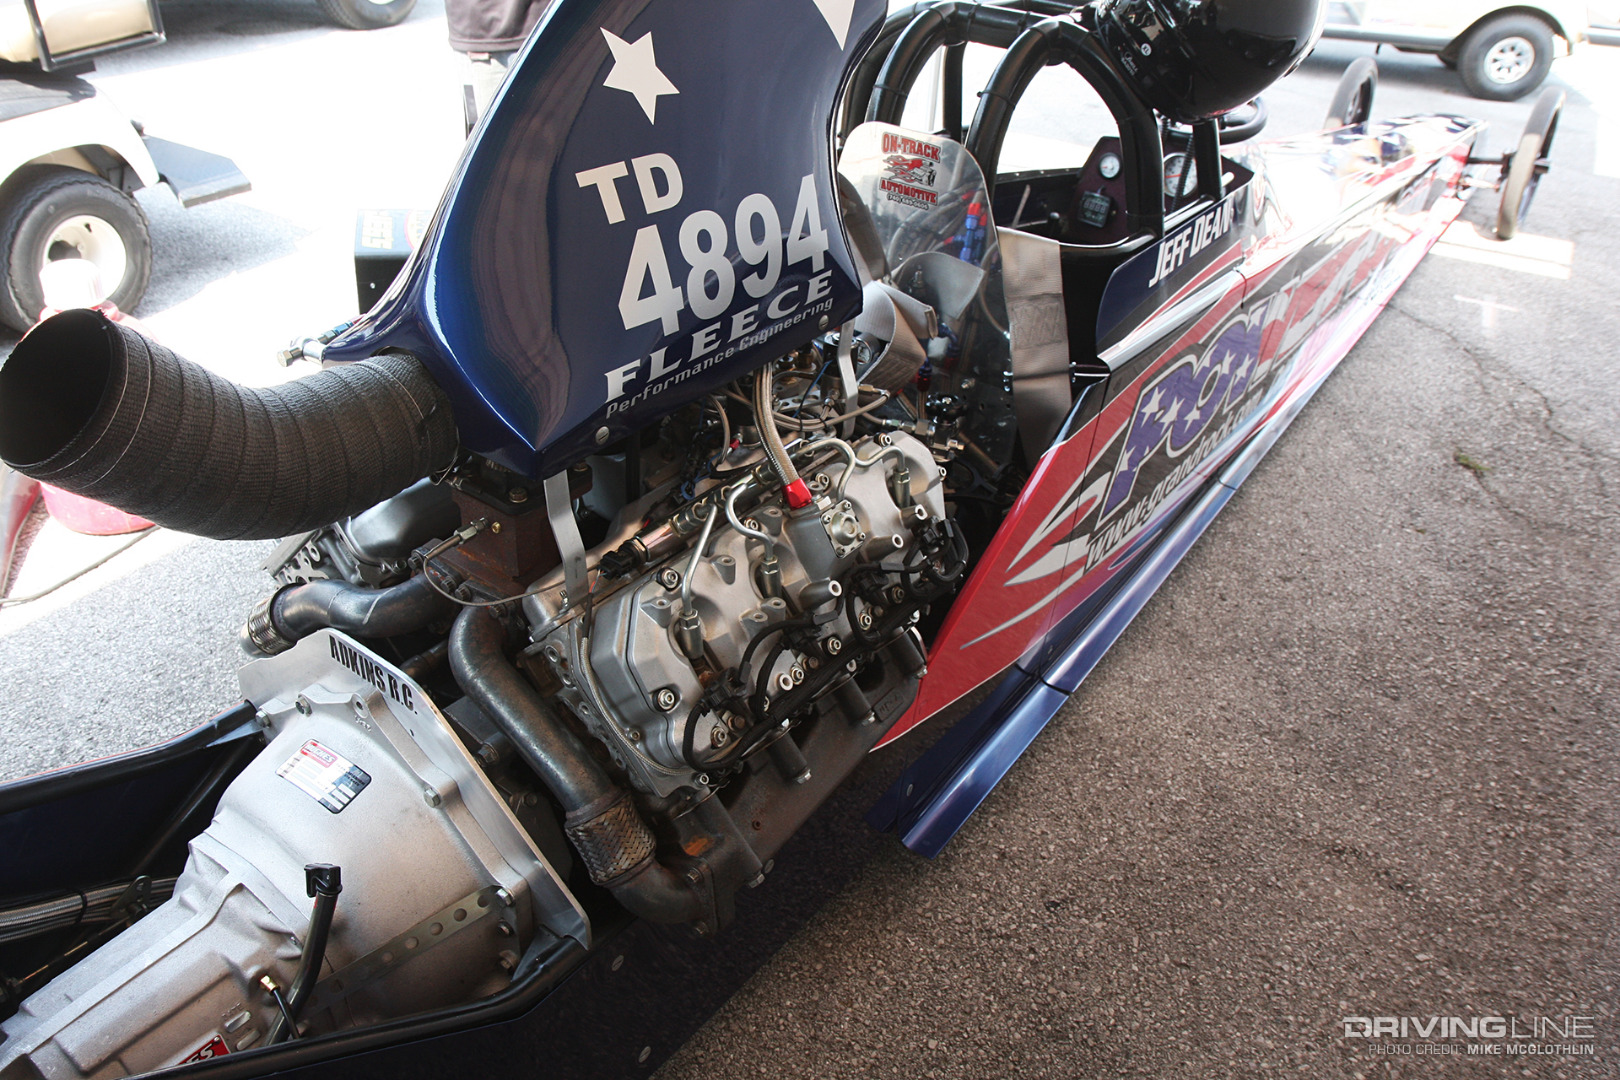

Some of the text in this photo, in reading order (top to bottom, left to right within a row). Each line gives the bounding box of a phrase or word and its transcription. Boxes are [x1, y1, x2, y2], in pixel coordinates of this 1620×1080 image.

[575, 153, 683, 225] TD
[881, 132, 941, 163] ON-TRACK
[880, 178, 937, 204] AUTOMOTIVE
[618, 173, 829, 337] 4894
[1148, 197, 1235, 288] JEFF DEAN
[604, 269, 833, 403] FLEECE
[605, 297, 833, 419] Performance Engineering
[329, 634, 419, 715] ADKINS R.C.
